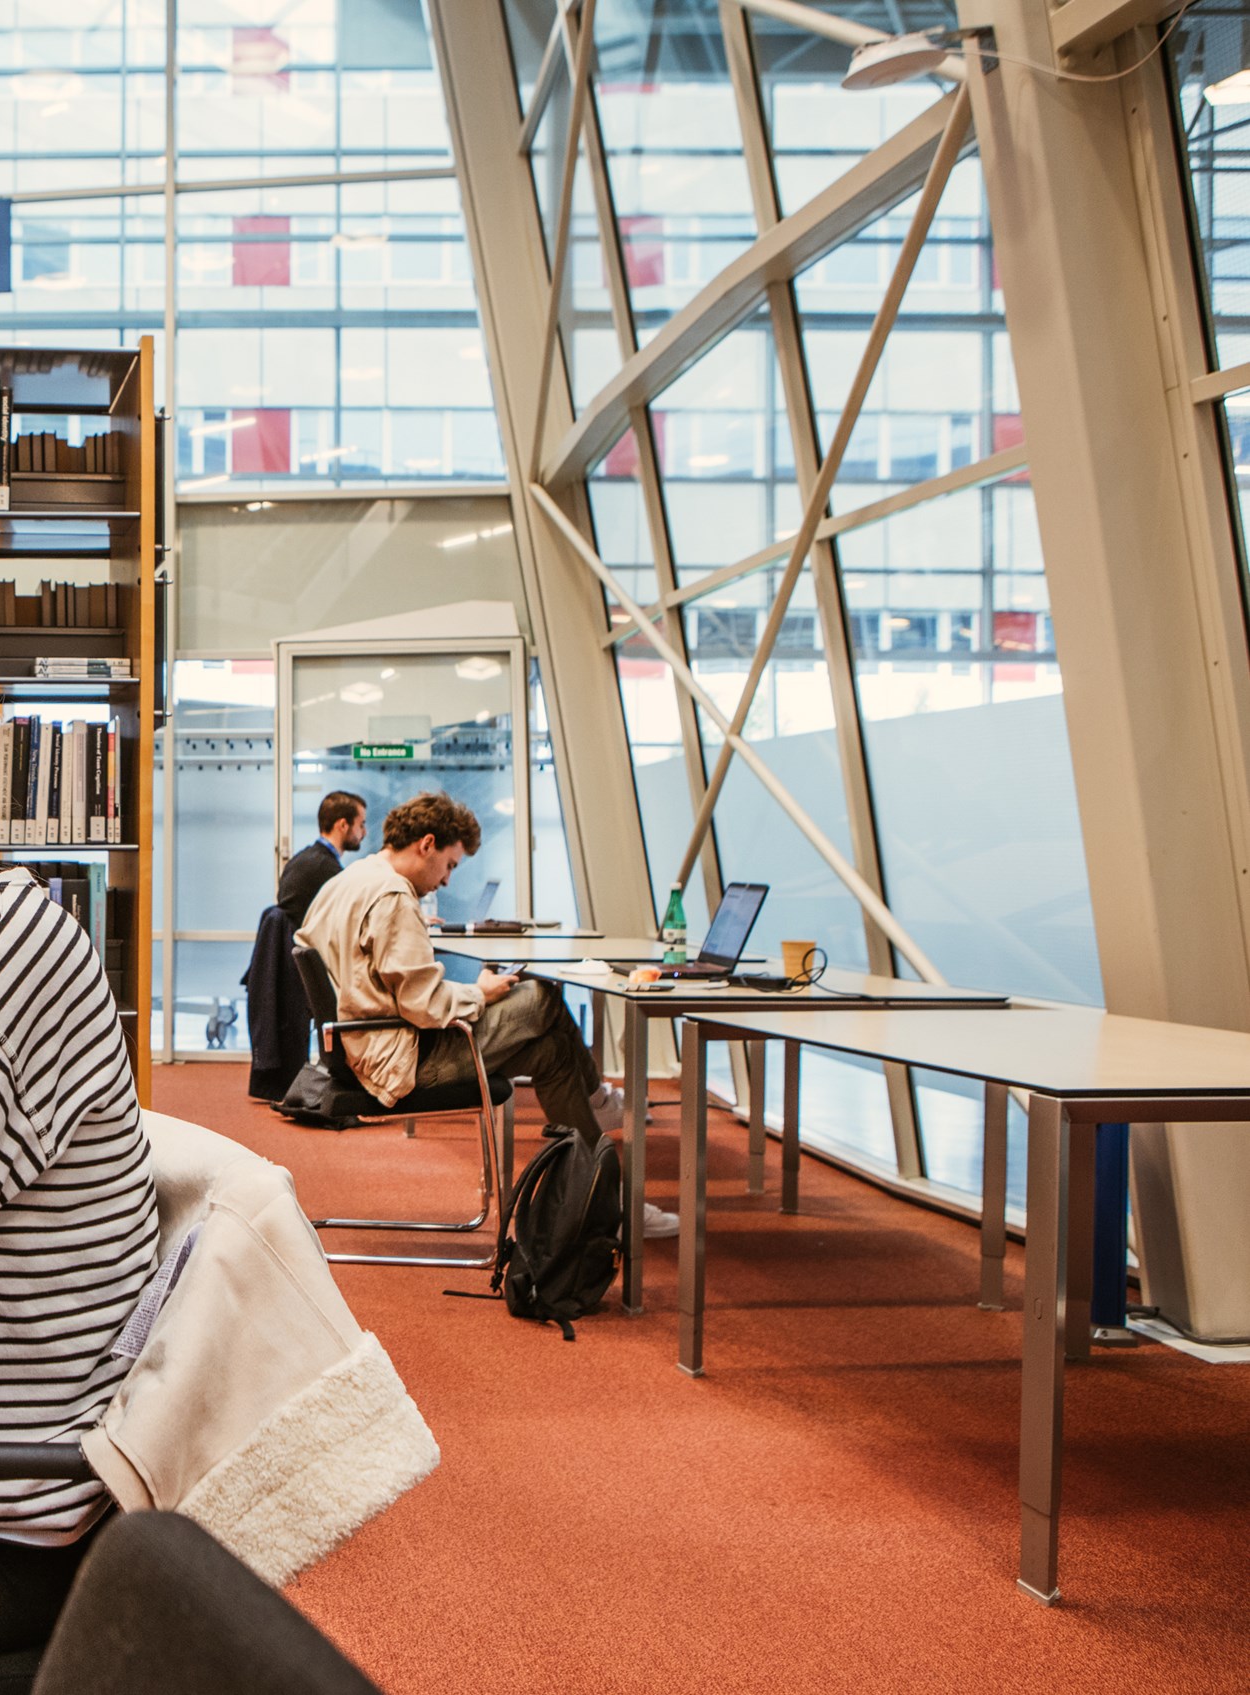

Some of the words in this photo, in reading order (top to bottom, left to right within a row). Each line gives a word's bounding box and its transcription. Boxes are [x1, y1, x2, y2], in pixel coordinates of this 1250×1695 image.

[0, 416, 9, 441] identity
[360, 748, 371, 757] No
[372, 747, 406, 757] Entrance
